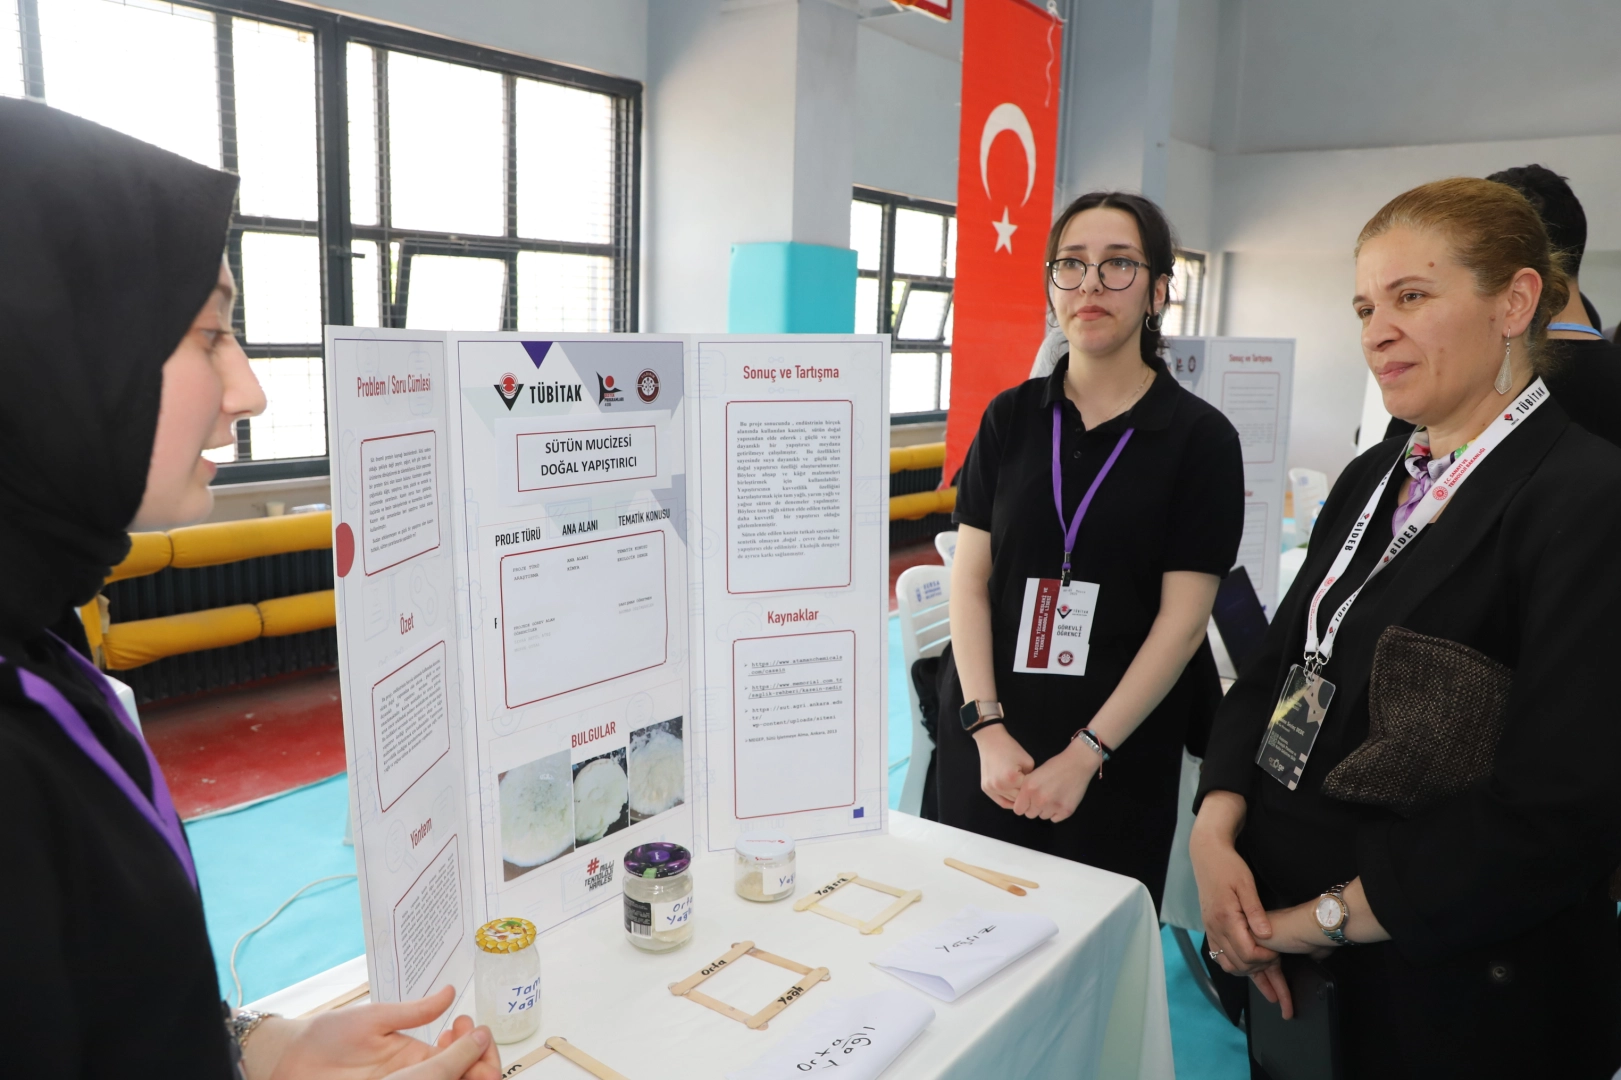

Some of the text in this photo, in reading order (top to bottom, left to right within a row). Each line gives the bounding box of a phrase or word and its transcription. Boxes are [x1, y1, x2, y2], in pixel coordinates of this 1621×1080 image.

[743, 365, 839, 383] Sonuç ve Tartışma
[357, 376, 386, 398] Problem
[392, 376, 406, 394] Soru
[407, 373, 431, 393] Cümlesi
[530, 381, 582, 404] TÜBİTAK
[1516, 387, 1545, 414] TÜBİTAK
[545, 434, 632, 454] SÜTÜN MUCİZESİ
[541, 456, 637, 476] DOĞAL YAPIŞTIRICI
[1449, 463, 1463, 477] SANAYİ
[1448, 467, 1467, 487] TEKNOLOJİ
[618, 508, 670, 526] TEMATİK KONUSU
[495, 526, 541, 547] PROJE TÜRÜ
[562, 520, 598, 536] ANA ALANI
[400, 612, 414, 636] Özet
[767, 608, 819, 626] Kaynaklar
[571, 721, 616, 748] BULGULAR
[410, 818, 432, 849] Yöntem
[701, 959, 727, 975] Orta
[512, 976, 540, 996] Tam
